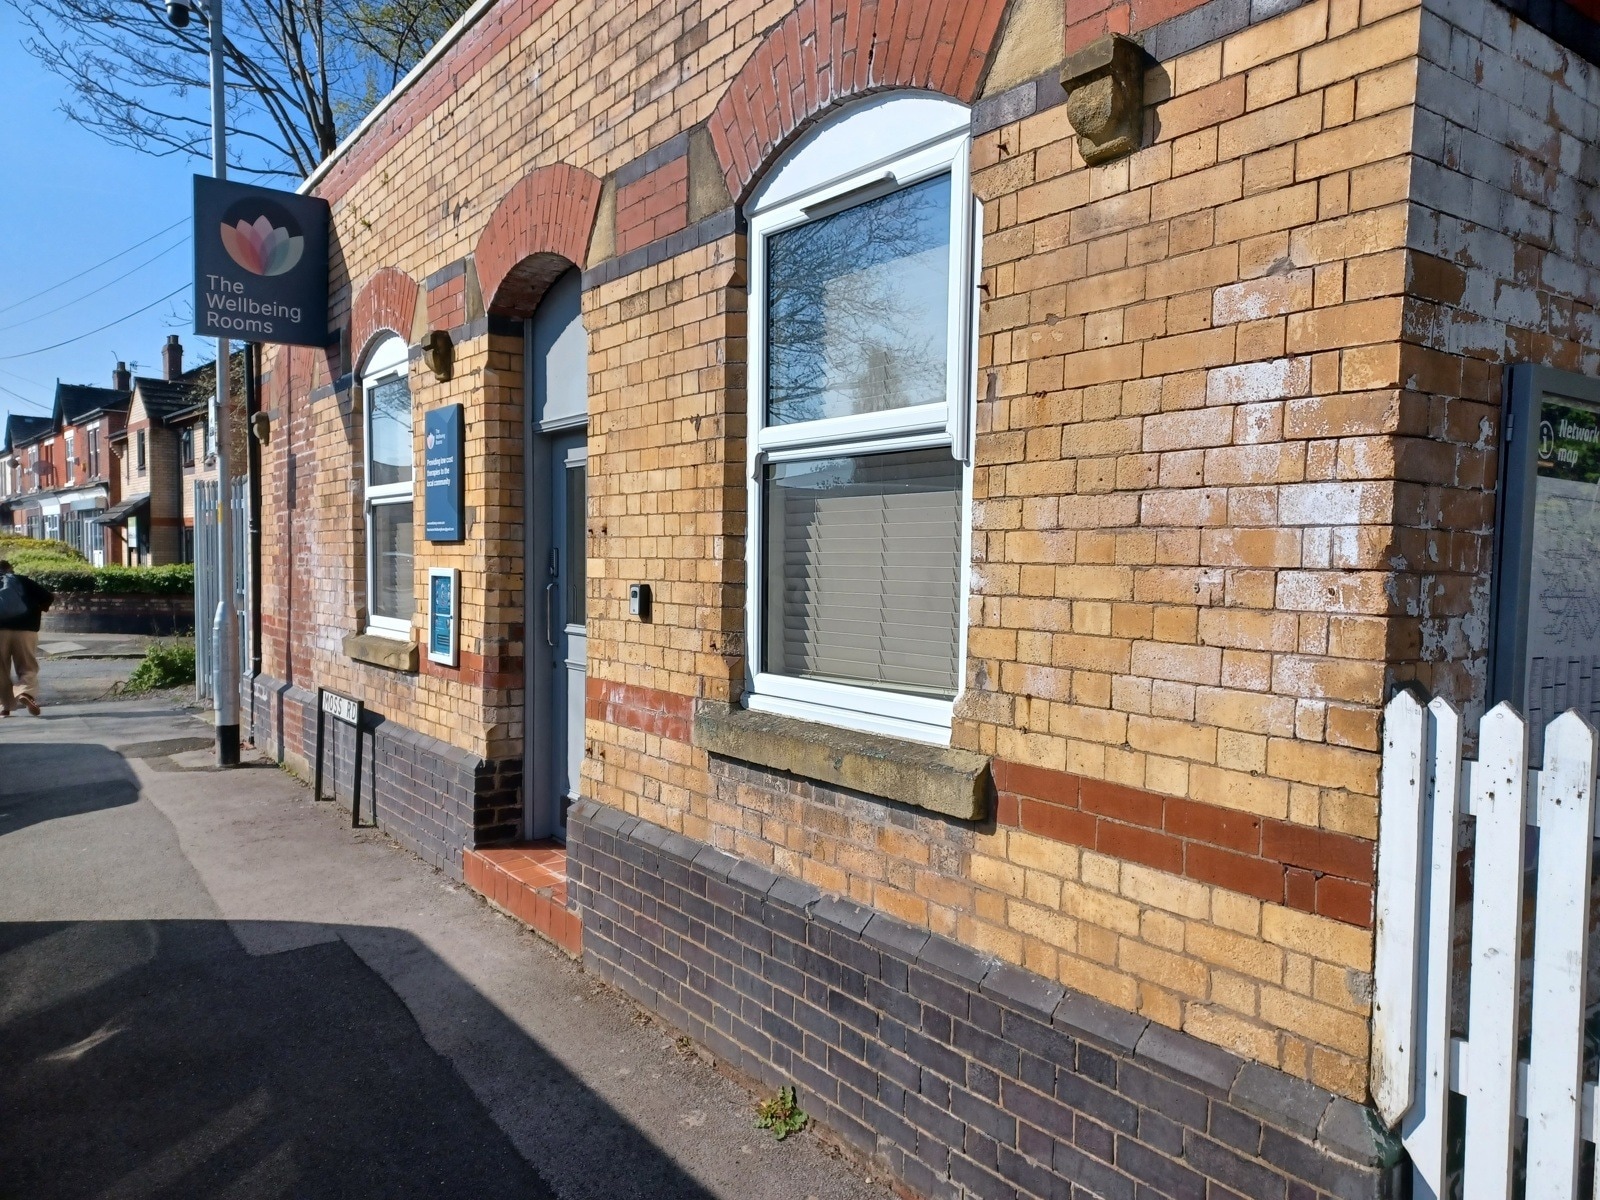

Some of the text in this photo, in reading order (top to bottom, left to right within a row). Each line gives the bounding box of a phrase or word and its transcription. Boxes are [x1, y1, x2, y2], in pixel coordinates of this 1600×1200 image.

[206, 274, 244, 294] The
[206, 292, 301, 323] Wellbeing
[207, 311, 273, 334] Rooms
[1559, 419, 1600, 444] Network
[427, 457, 441, 467] Providing
[1557, 447, 1579, 468] map
[324, 692, 356, 720] MOSS RD
